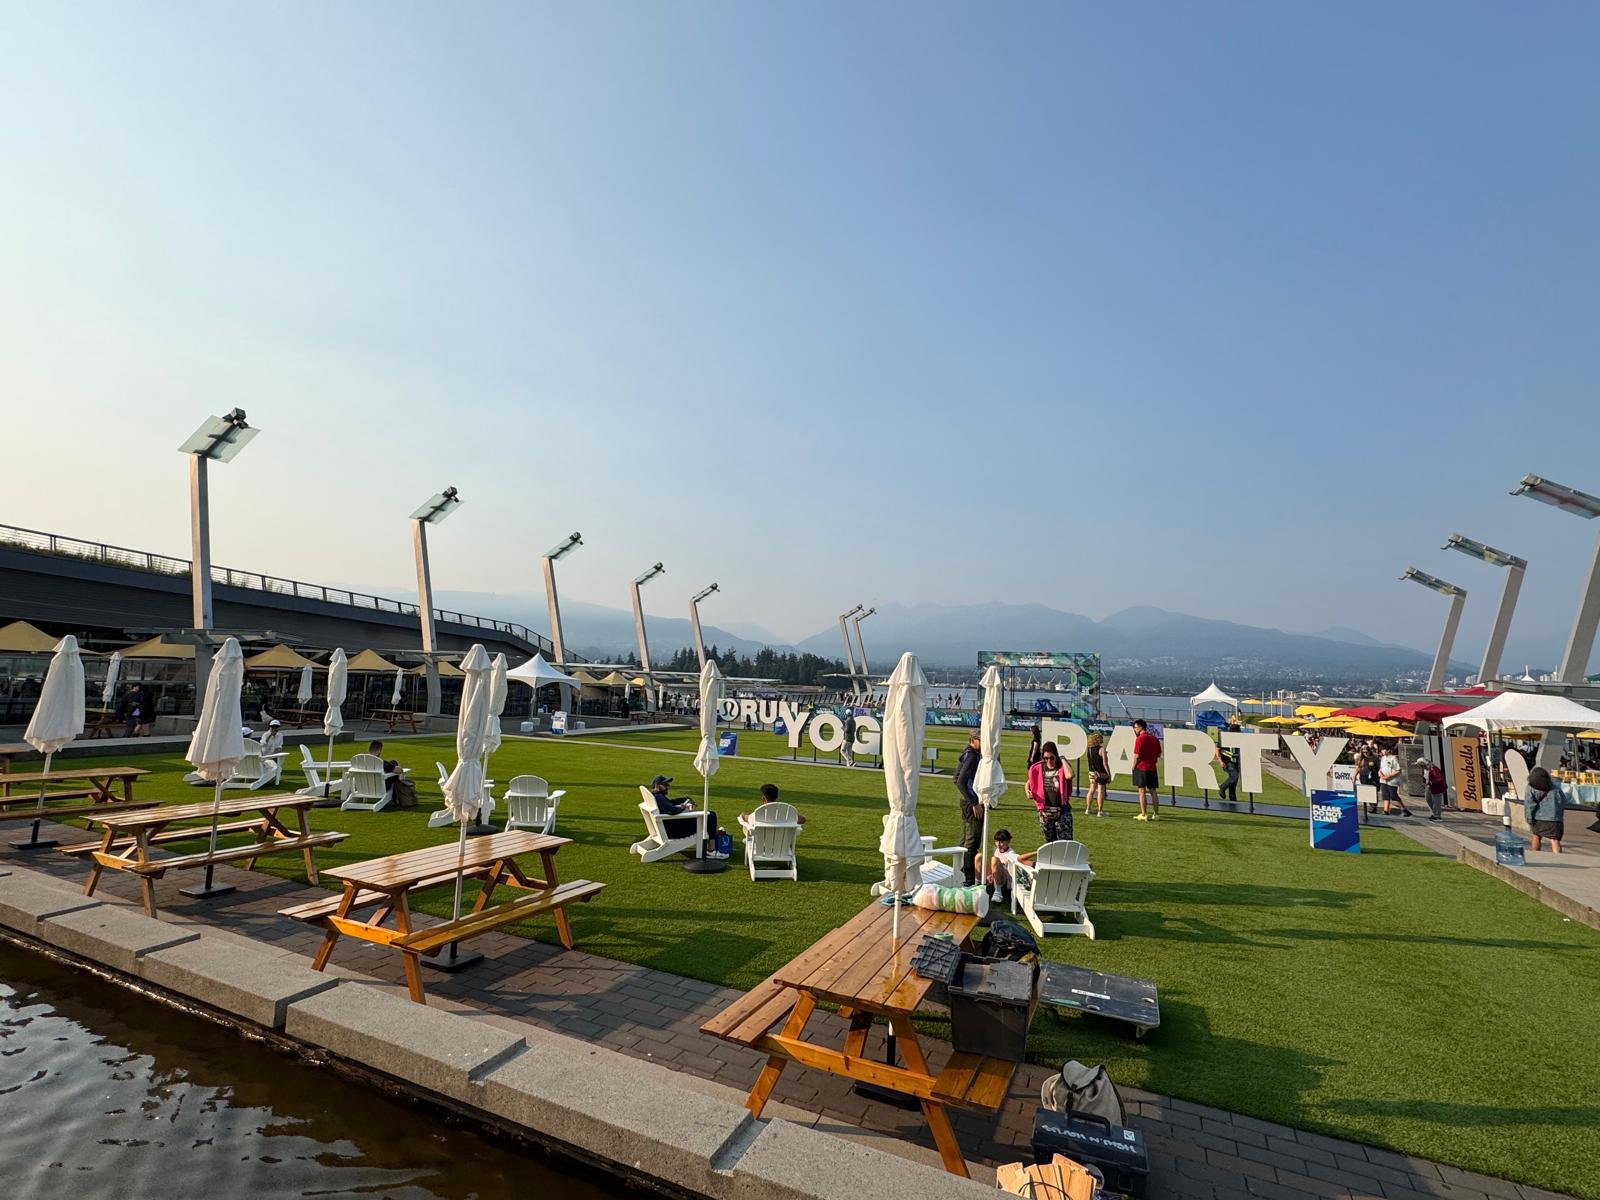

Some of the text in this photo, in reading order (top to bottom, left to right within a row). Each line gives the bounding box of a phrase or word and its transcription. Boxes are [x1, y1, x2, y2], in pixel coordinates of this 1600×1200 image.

[740, 699, 799, 724] RUN
[779, 711, 881, 756] YOG
[1042, 720, 1348, 797] PARTY
[1458, 745, 1477, 801] Barebells
[1312, 804, 1342, 812] PLEASE
[1313, 815, 1339, 823] CLIMB
